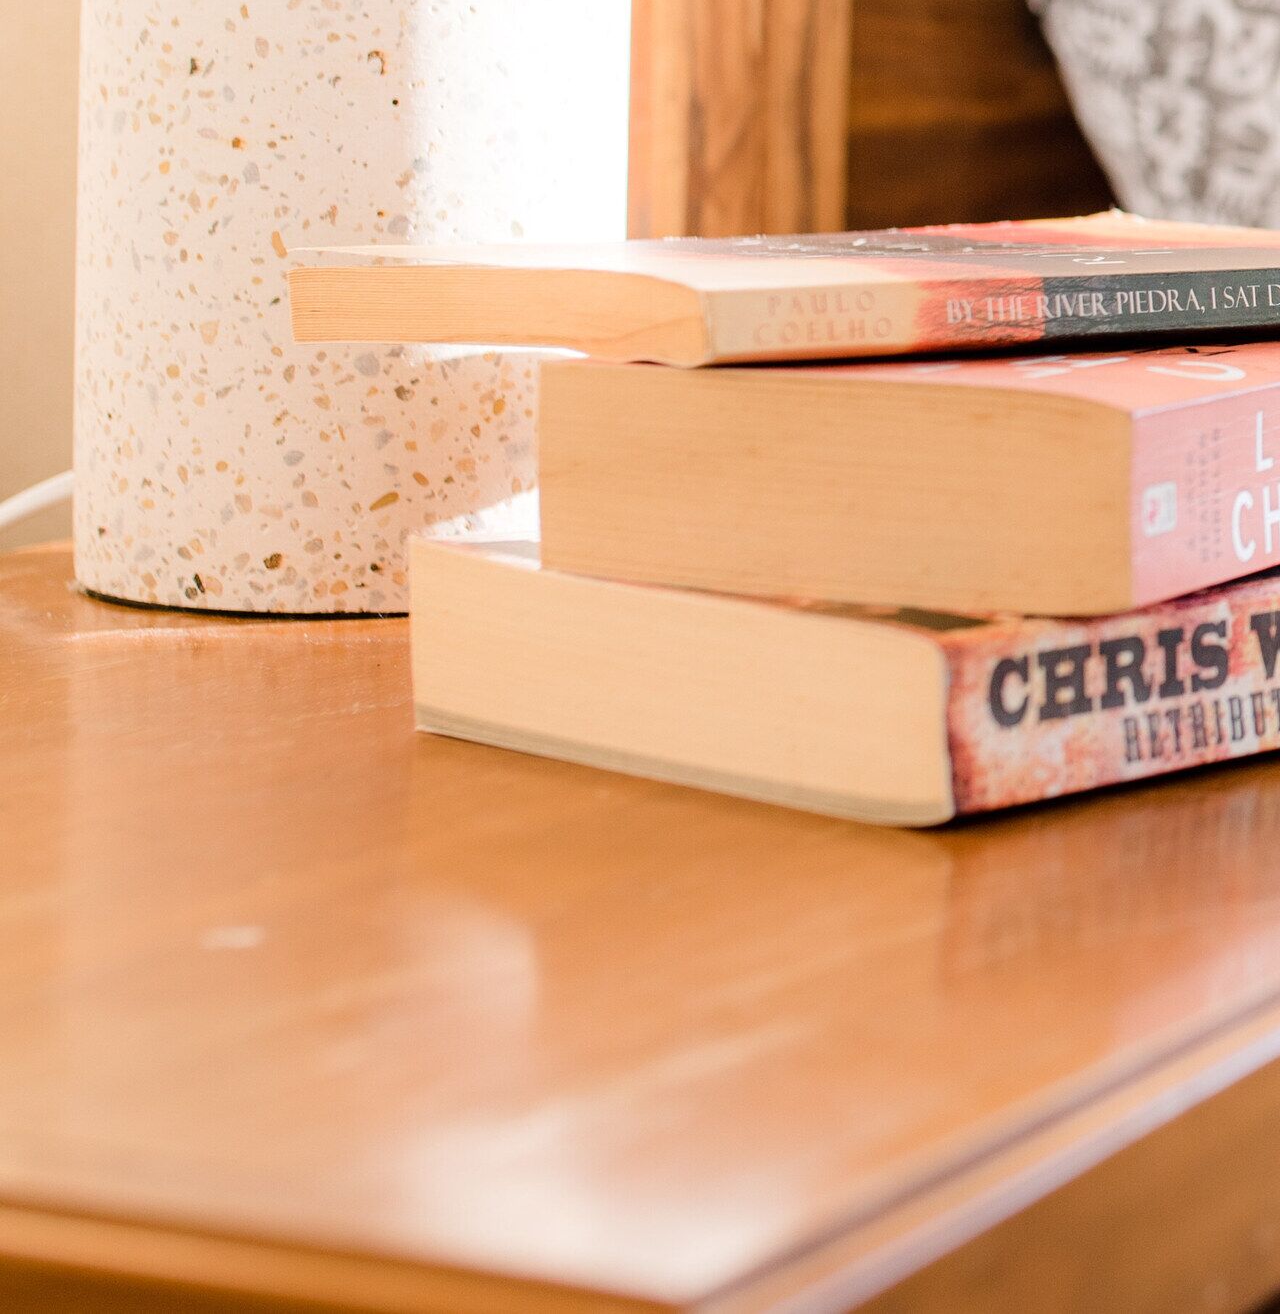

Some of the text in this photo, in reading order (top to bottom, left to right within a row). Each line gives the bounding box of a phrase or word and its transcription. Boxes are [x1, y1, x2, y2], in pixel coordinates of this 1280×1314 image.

[768, 290, 876, 316] PAULO
[946, 298, 973, 324] BY
[985, 295, 1031, 322] THE
[1035, 292, 1108, 319] RIVER
[1115, 289, 1206, 315] PIEDRA,
[1212, 286, 1218, 311] I
[1223, 284, 1260, 309] SAT
[753, 317, 893, 344] COELHO
[988, 619, 1229, 728] CHRIS
